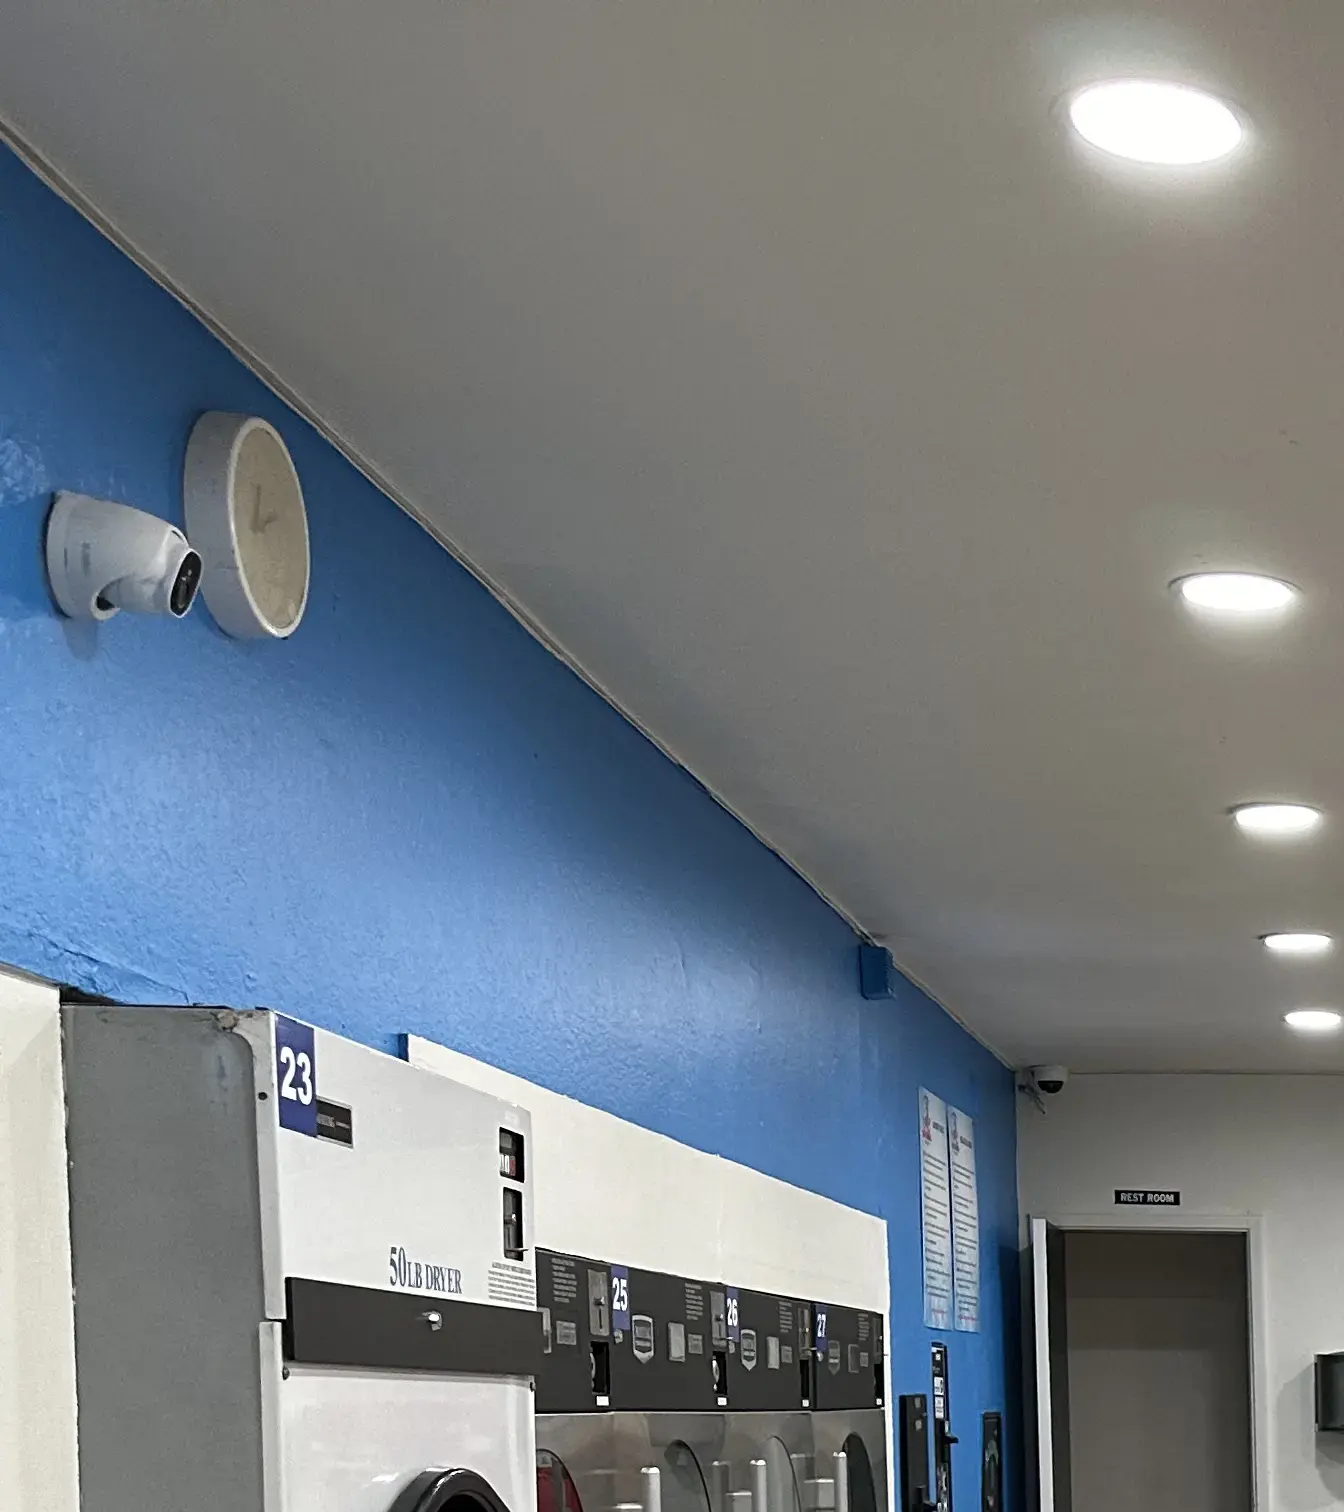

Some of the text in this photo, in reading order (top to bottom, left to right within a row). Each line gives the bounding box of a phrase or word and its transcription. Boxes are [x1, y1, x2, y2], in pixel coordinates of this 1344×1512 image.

[280, 1046, 312, 1105] 23
[1120, 1192, 1174, 1203] REST ROOM
[425, 1263, 462, 1294] DRYER
[612, 1276, 628, 1311] 25
[726, 1297, 738, 1327] 26
[816, 1313, 826, 1338] 27
